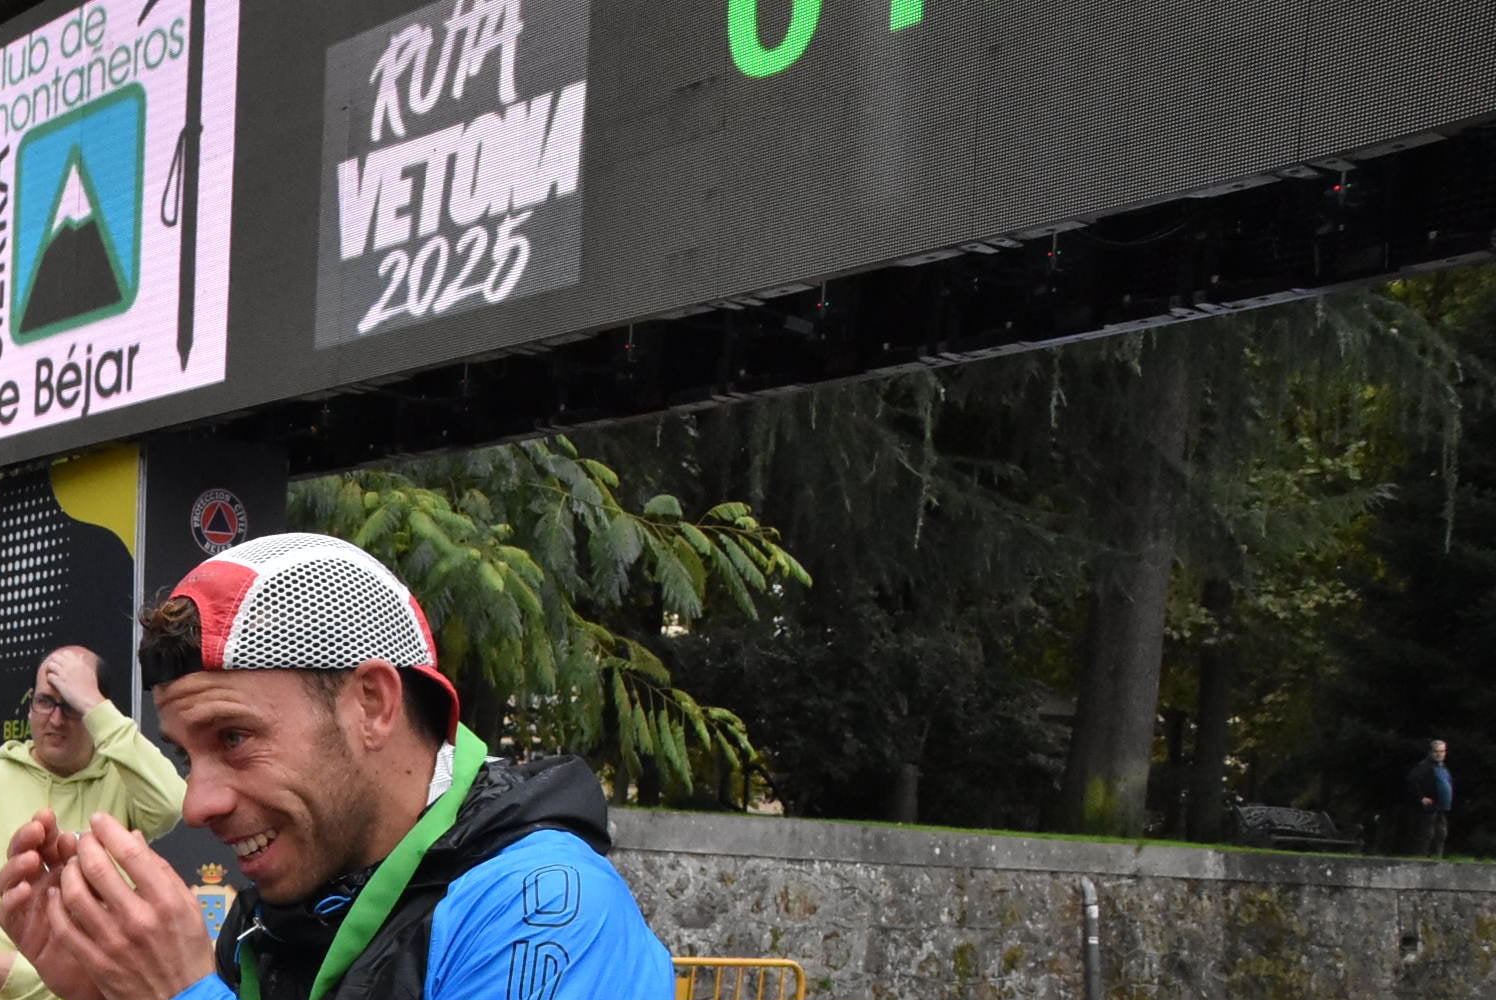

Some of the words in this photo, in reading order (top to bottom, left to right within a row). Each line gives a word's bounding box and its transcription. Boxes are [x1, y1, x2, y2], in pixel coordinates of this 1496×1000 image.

[60, 4, 107, 58] de
[369, 0, 524, 142] RUTA
[336, 79, 587, 262] VETONA
[357, 209, 533, 334] 2025
[34, 342, 140, 418] Béjar
